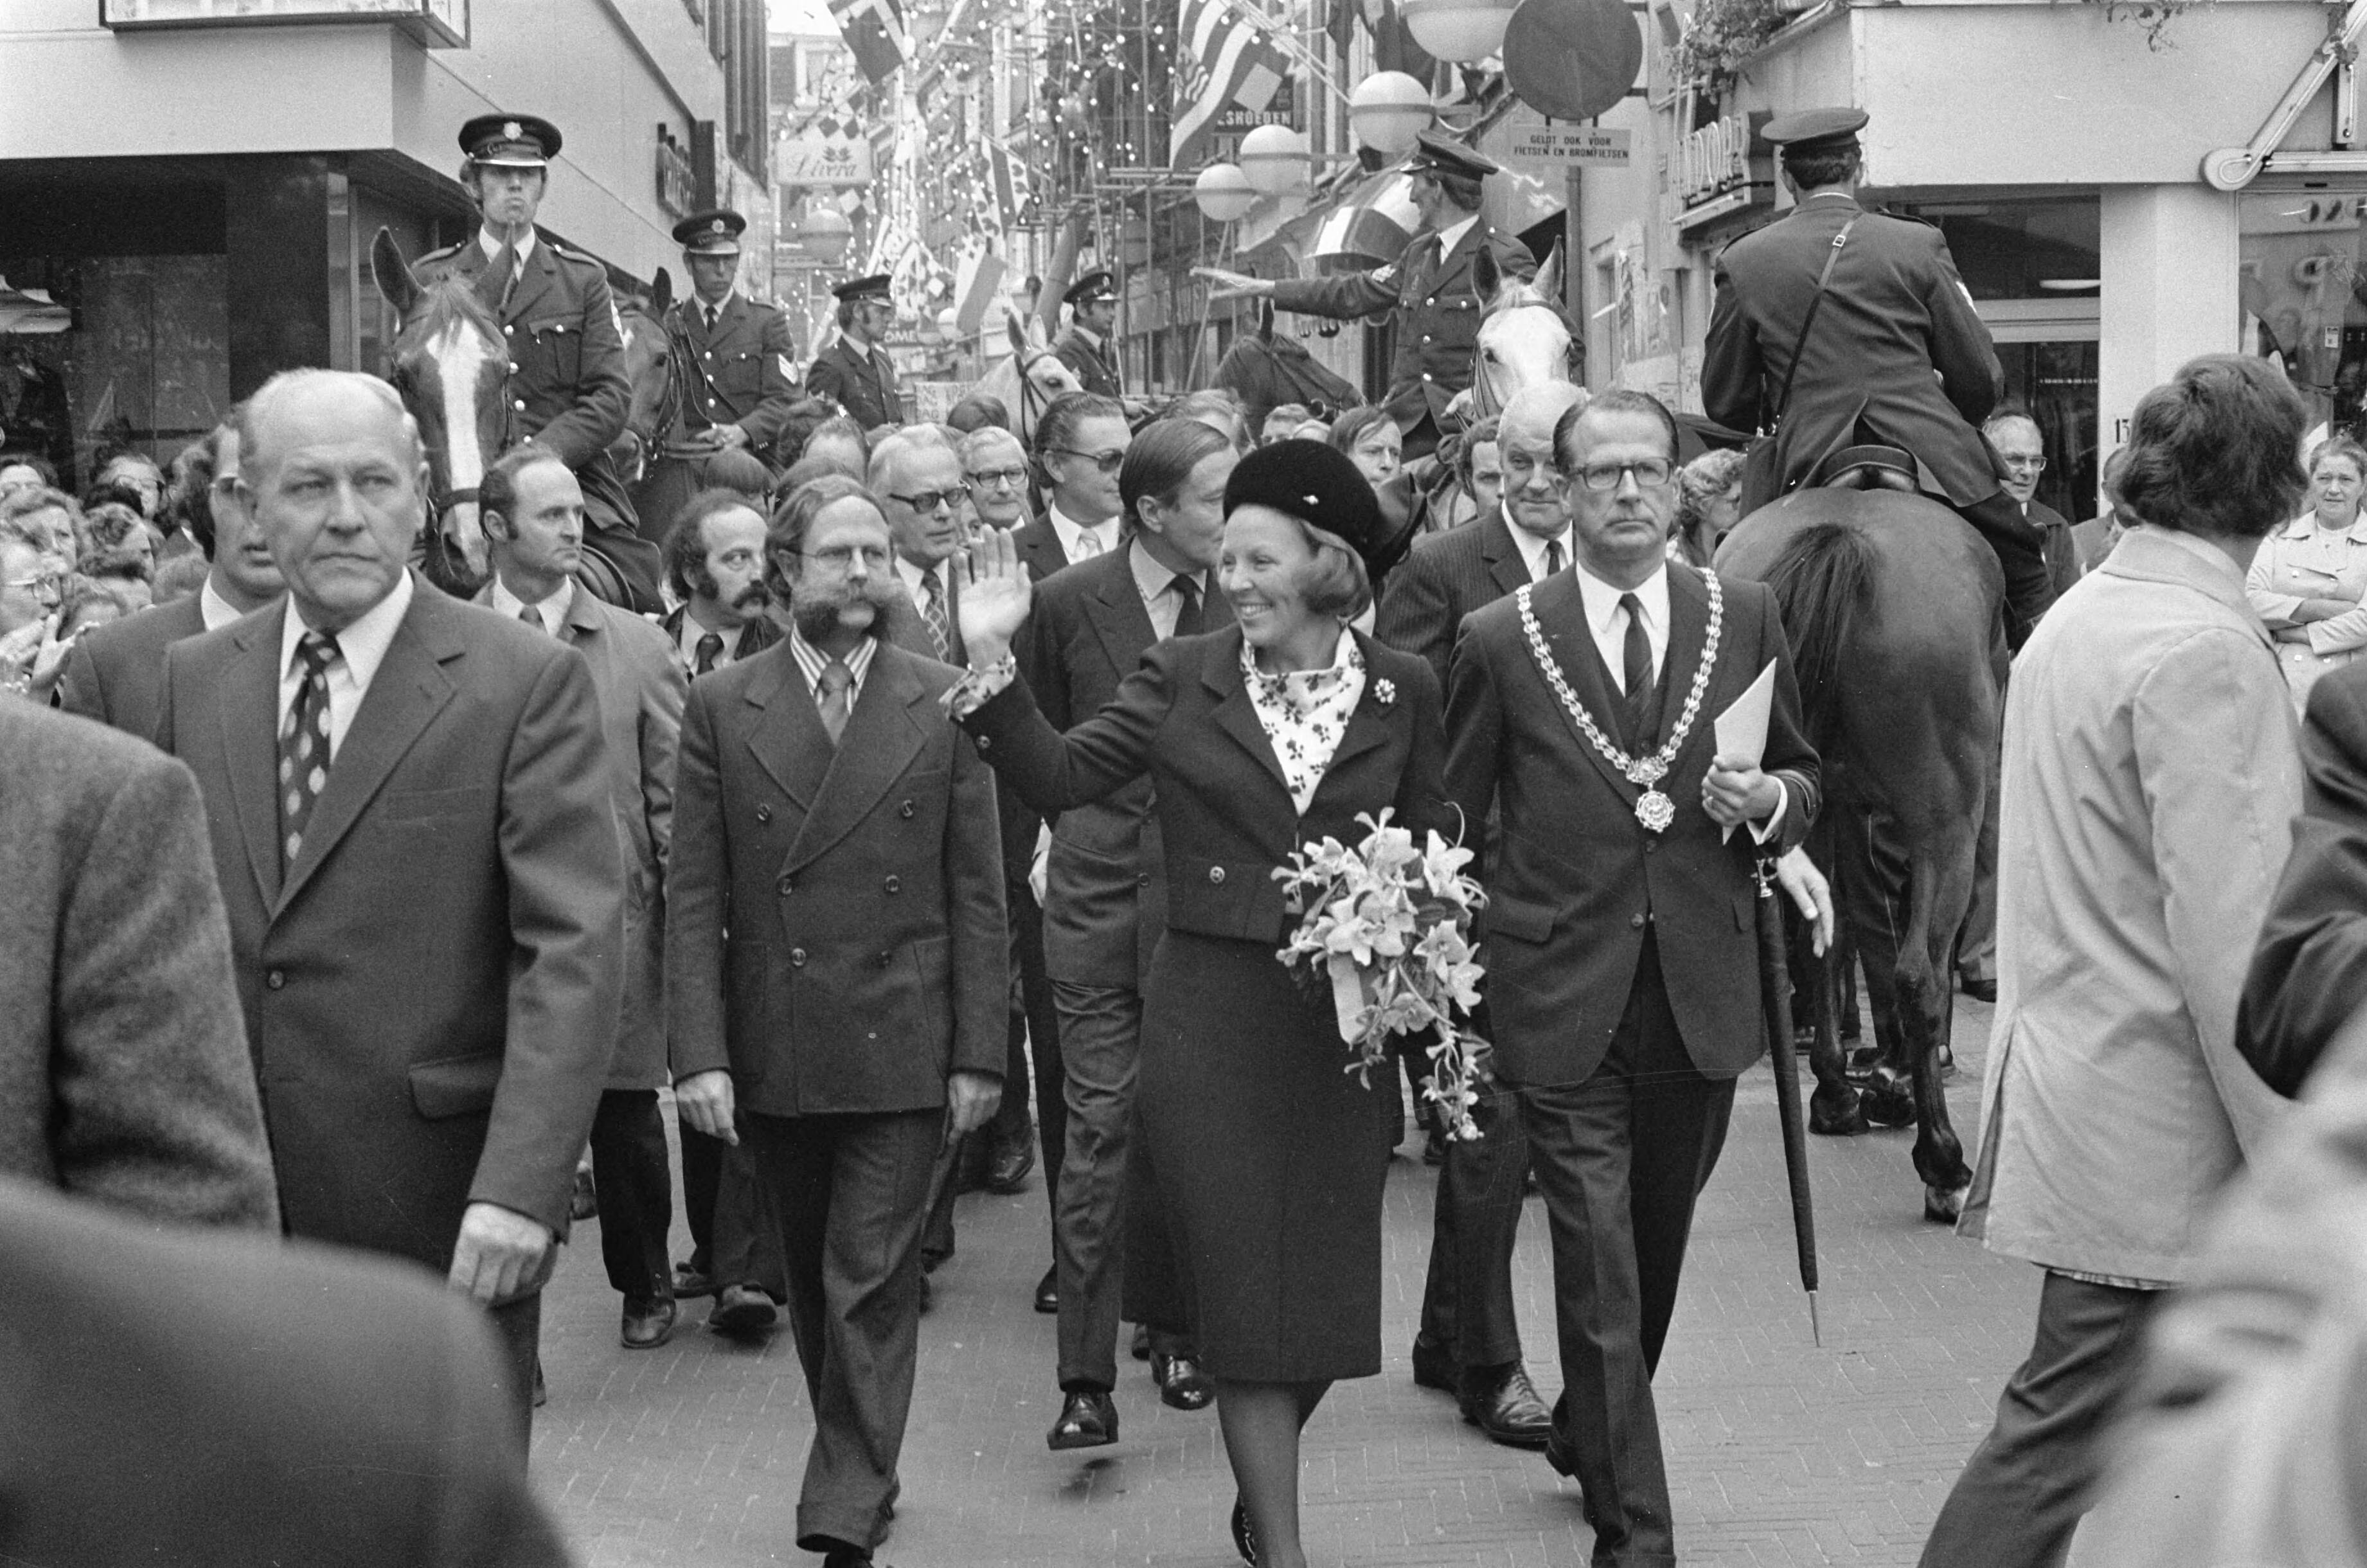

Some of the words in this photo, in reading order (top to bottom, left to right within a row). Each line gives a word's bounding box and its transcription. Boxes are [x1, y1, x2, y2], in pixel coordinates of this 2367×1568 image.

[1530, 134, 1557, 145] GELDT
[1564, 136, 1581, 145] OOK
[1588, 136, 1611, 146] VOOR
[1514, 146, 1550, 156] FIETSEN
[1553, 147, 1565, 157] EN
[1569, 147, 1629, 159] BROMFIETSEN
